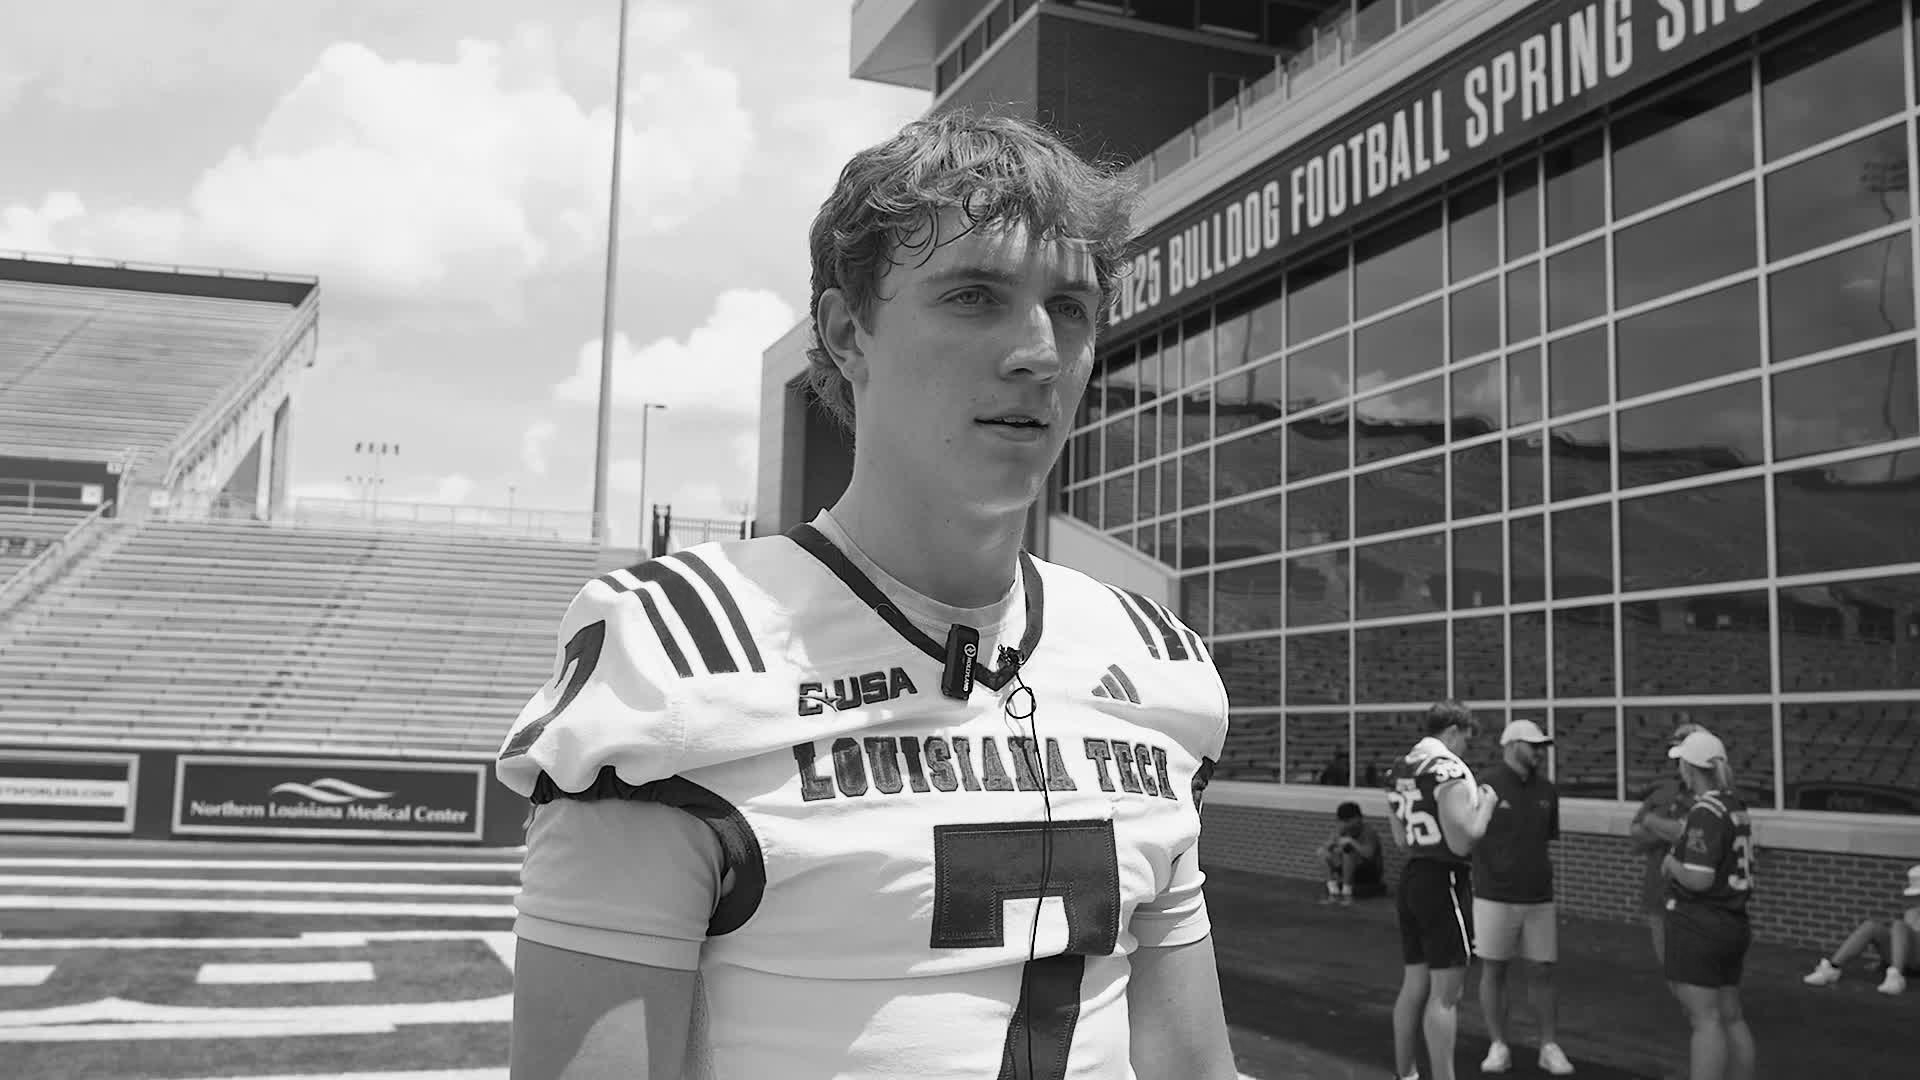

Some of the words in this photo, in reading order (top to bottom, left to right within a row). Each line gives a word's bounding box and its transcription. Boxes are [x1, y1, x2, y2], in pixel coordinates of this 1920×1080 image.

[1168, 181, 1280, 297] BULLDOG
[1290, 88, 1451, 236] FOOTBALL
[1463, 0, 1633, 148] SPRING
[190, 800, 266, 817] Northern
[268, 802, 344, 819] Louisiana
[346, 804, 411, 821] Medical
[413, 805, 469, 823] Center
[792, 736, 1078, 802] LOUISIANA
[1082, 737, 1178, 801] TECH
[930, 818, 1121, 1080] 7
